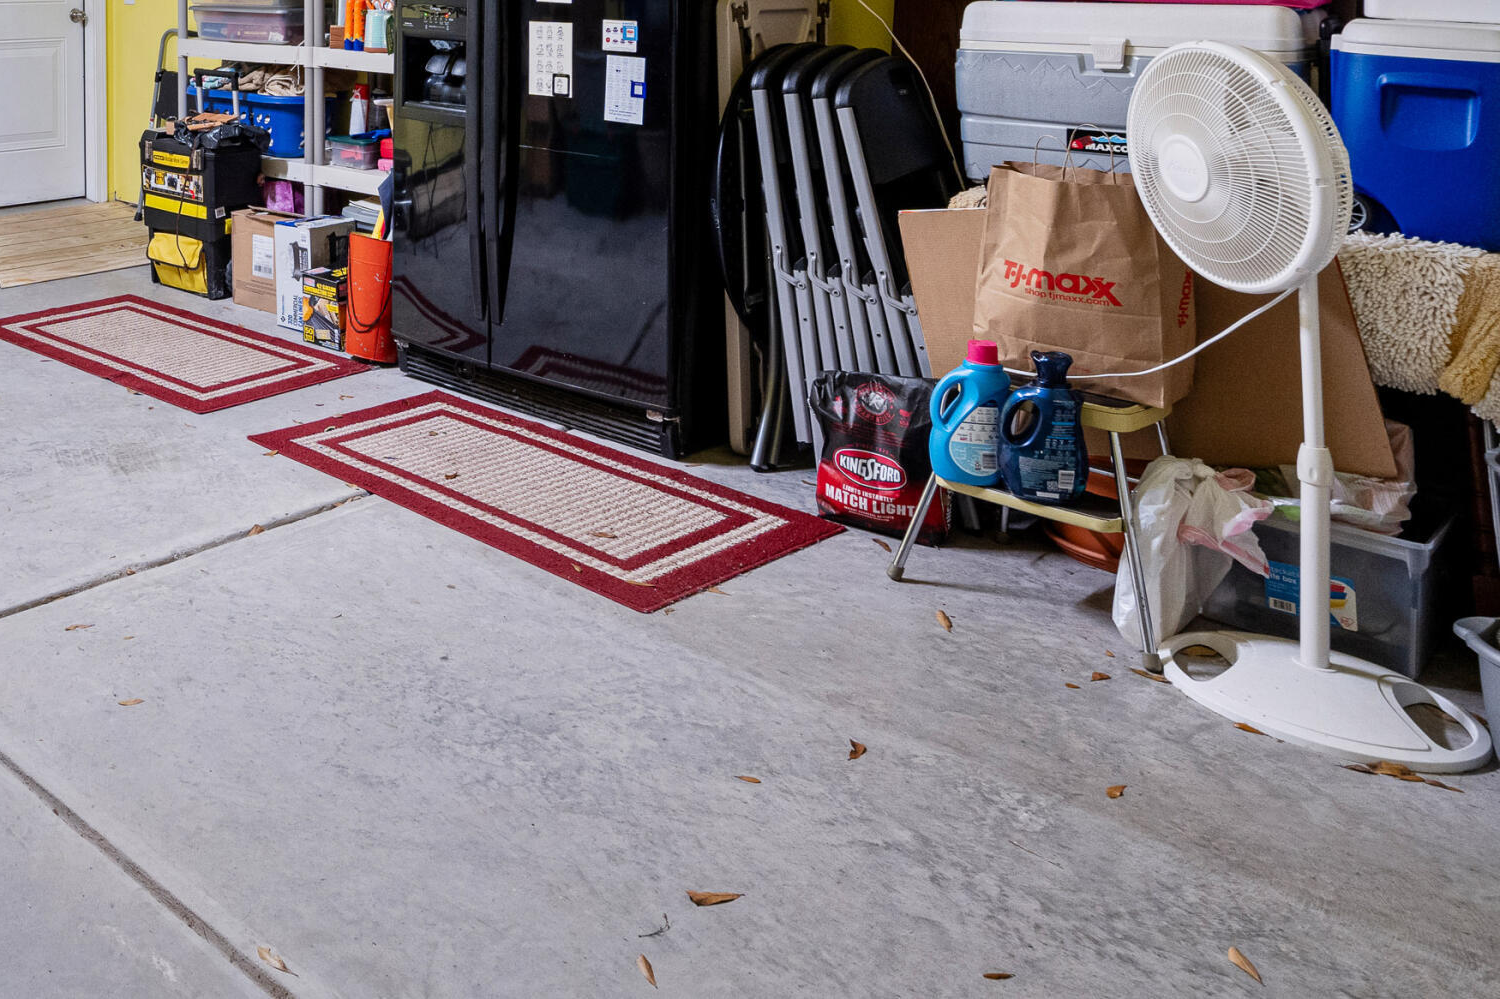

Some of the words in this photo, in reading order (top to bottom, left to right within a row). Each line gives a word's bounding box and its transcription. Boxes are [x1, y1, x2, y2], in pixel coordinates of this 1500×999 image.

[1024, 287, 1047, 299] shop
[1049, 291, 1110, 306] tjmaxx.com
[839, 454, 901, 482] KINGSFORD
[825, 482, 868, 511] MATCH
[872, 501, 915, 517] LIGHT
[842, 483, 861, 495] LIGHTS
[862, 490, 894, 503] INSTANTLY
